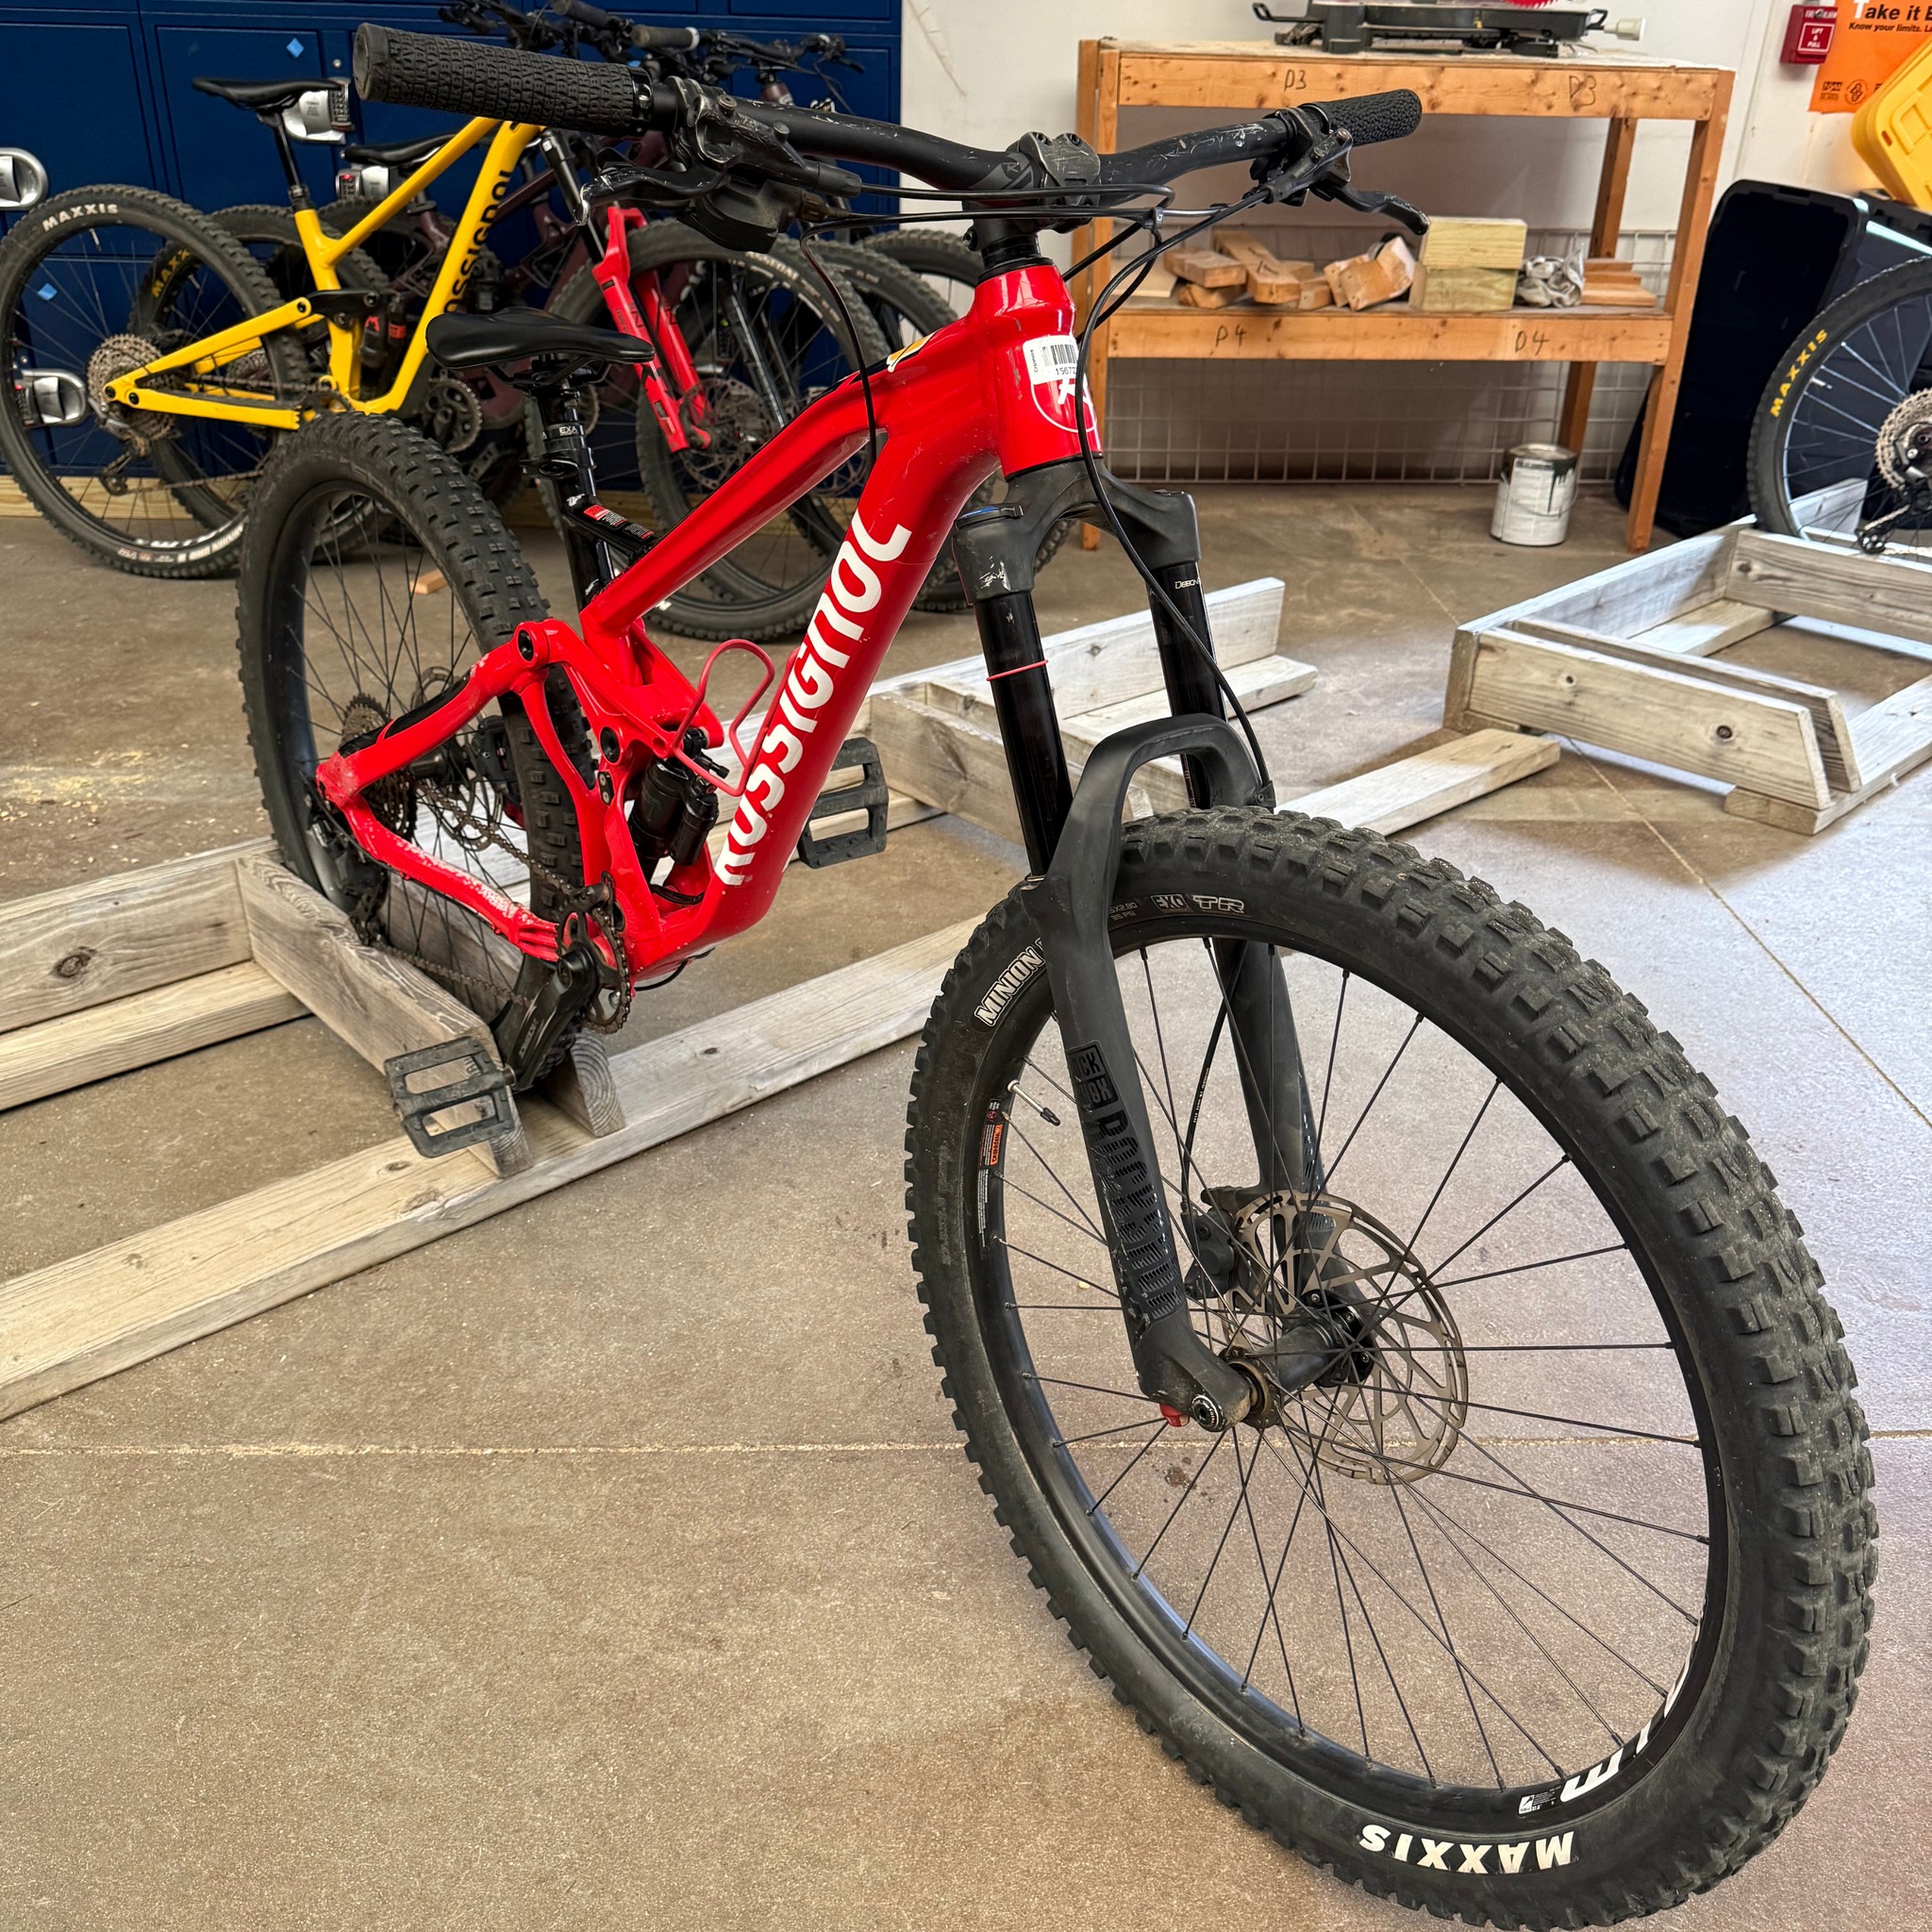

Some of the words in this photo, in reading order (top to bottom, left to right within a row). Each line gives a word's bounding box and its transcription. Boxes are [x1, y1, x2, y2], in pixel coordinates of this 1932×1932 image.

[1853, 0, 1900, 20] Take
[1906, 5, 1921, 21] it
[1848, 22, 1873, 31] Know
[1874, 24, 1895, 33] your
[42, 203, 119, 232] MAXXIS
[151, 248, 190, 298] MAXX
[1515, 330, 1550, 356] D4
[1770, 329, 1827, 417] MAXXIS
[1191, 894, 1244, 914] TR
[974, 946, 1046, 1026] MINION
[1358, 1824, 1574, 1874] MAXXIS
